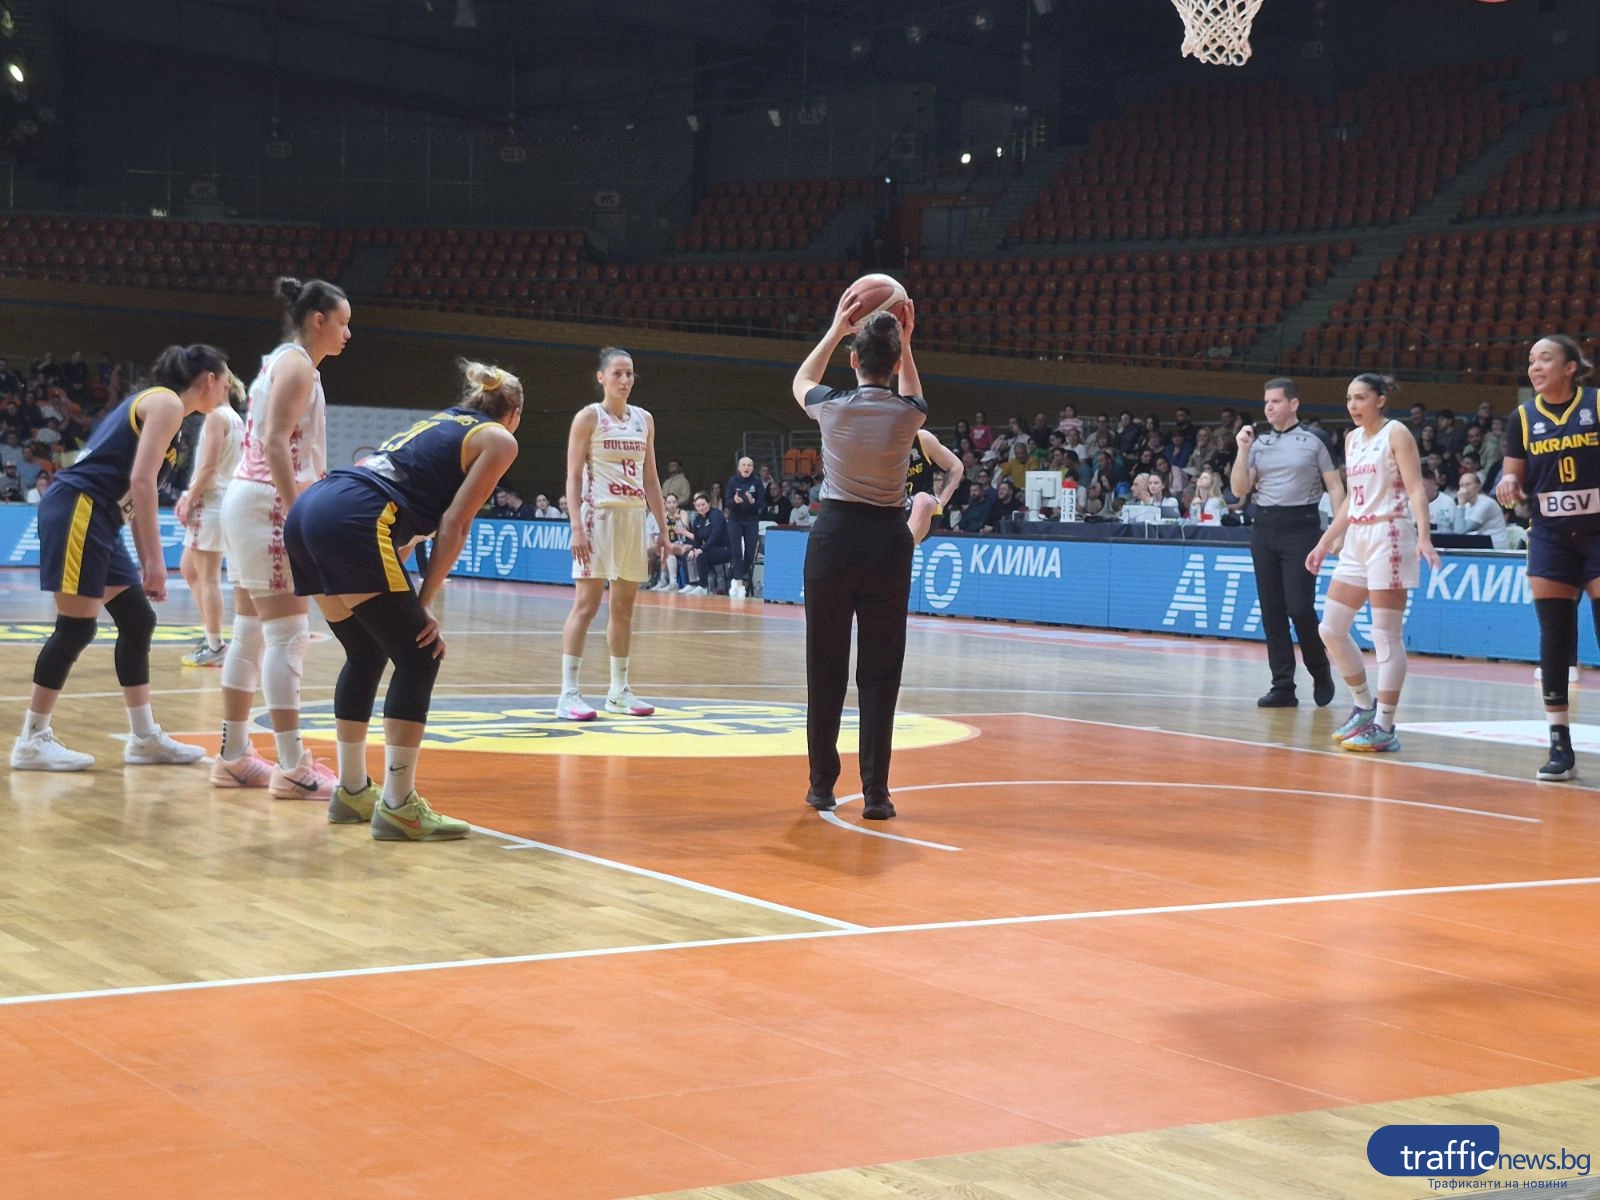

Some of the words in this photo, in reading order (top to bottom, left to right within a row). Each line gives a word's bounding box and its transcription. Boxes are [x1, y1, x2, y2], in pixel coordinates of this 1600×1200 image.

[603, 440, 646, 452] BULGARI
[1530, 432, 1599, 455] UKRAINE
[621, 459, 636, 476] 13
[1346, 464, 1377, 477] LGARIA
[1558, 456, 1576, 483] 19
[1546, 493, 1591, 513] BGV
[522, 525, 573, 550] КЛИМ
[970, 543, 1061, 579] КЛИМА
[1426, 563, 1534, 605] КЛИМ
